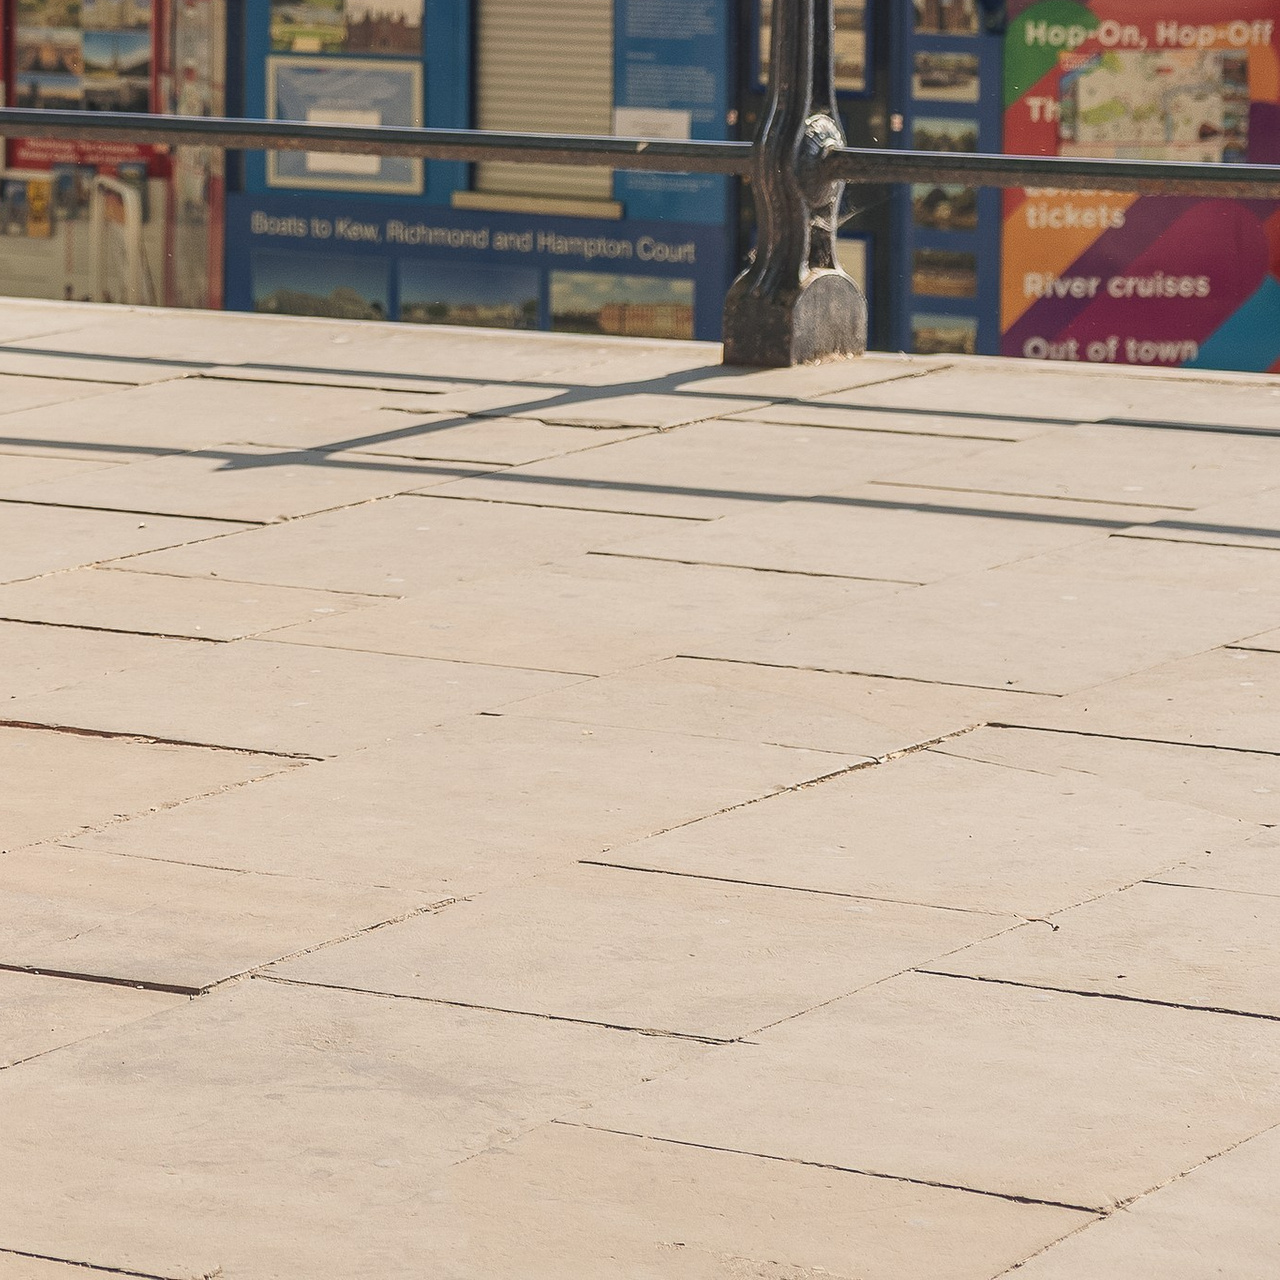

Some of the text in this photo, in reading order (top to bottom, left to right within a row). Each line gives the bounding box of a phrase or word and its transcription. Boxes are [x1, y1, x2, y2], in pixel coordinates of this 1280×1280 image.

[1024, 19, 1274, 50] Hop-On, Hop-Off
[1025, 201, 1126, 229] tickets
[251, 211, 697, 264] Boats to Kew, Richmond and Hampton Court
[1023, 270, 1210, 298] River cruises
[1023, 335, 1198, 362] Out of town
